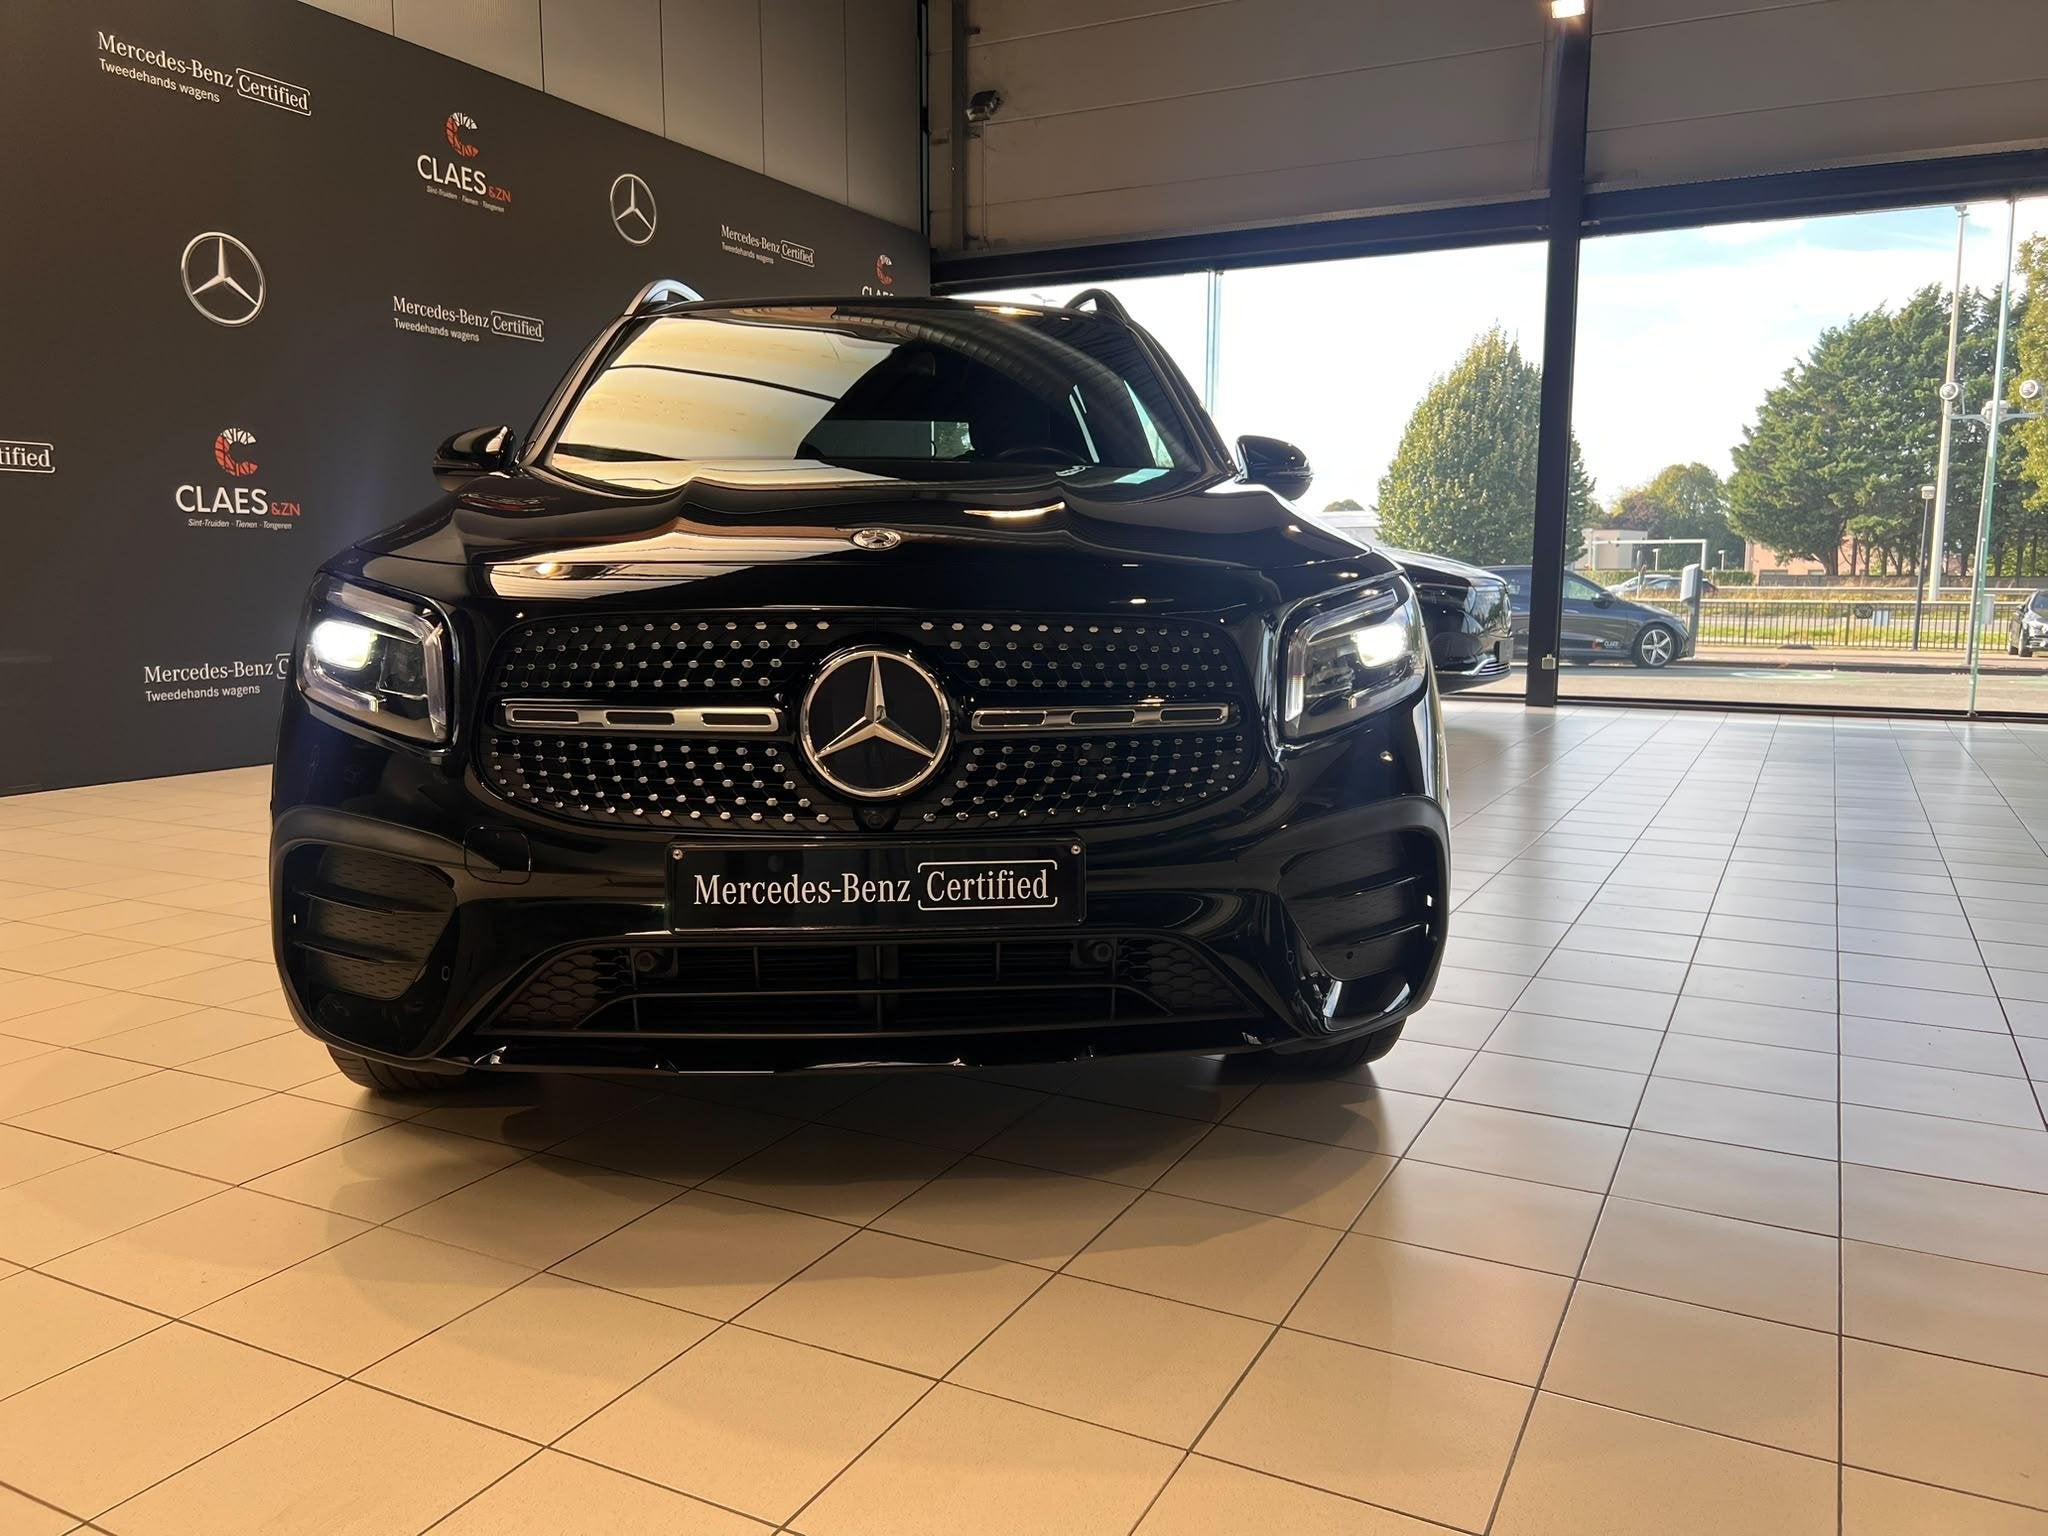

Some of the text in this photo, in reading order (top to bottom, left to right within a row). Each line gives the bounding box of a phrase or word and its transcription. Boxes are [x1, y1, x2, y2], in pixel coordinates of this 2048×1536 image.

[98, 31, 309, 110] Mercedes-Benz Certified
[98, 58, 220, 103] Tweedehands wagens
[417, 155, 487, 195] CLAES
[488, 186, 512, 202] &ZN
[721, 224, 814, 264] Mercedes-Benz Certified
[393, 296, 542, 337] Mercedes-Benz Certified
[393, 317, 480, 342] Tweedehands wagens
[175, 485, 301, 516] CLAES &ZN
[143, 660, 273, 684] Mercedes-Benz
[145, 684, 261, 702] Tweedehands wagens
[693, 869, 1050, 905] Mercedes-Benz Certified
